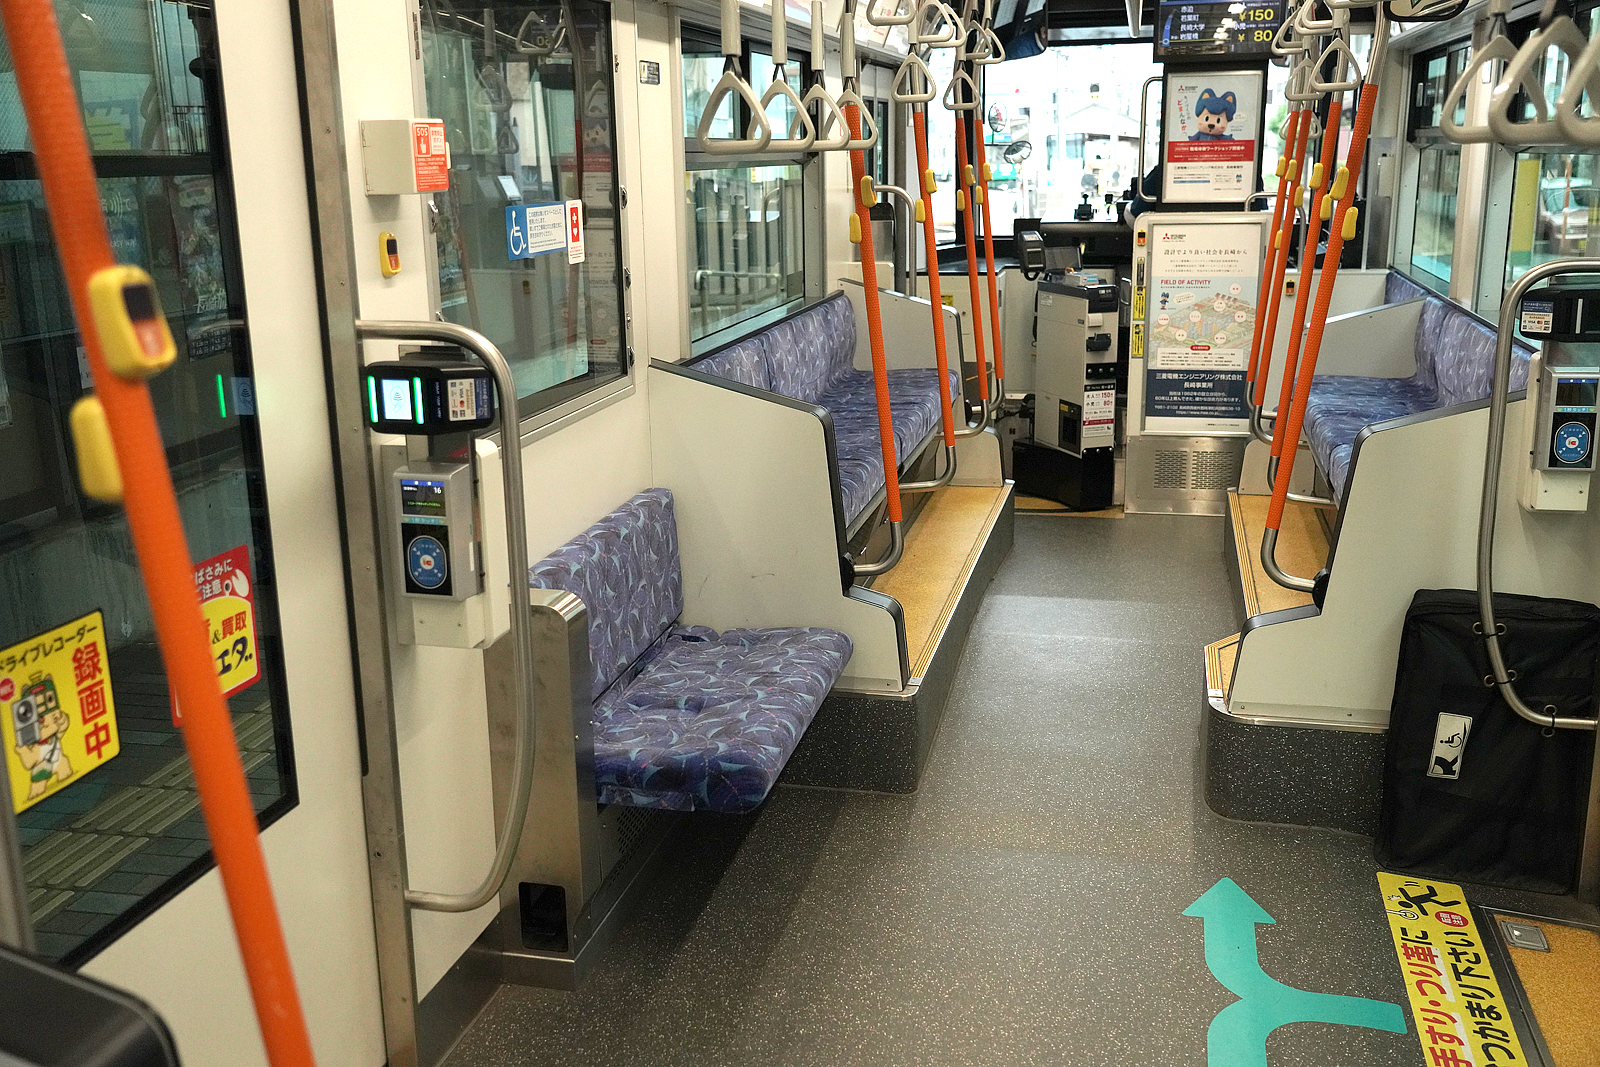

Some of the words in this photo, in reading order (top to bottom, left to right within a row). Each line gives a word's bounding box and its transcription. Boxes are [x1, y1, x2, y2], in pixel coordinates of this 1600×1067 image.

[1180, 23, 1205, 31] 長崎大学
[1253, 29, 1273, 42] 80
[416, 127, 429, 137] SOS
[1156, 372, 1243, 381] 三菱電機エンジニアリング株式会社
[1184, 381, 1214, 389] 長崎事業所
[433, 486, 442, 494] 16
[72, 641, 112, 760] 録画中
[1400, 926, 1473, 1067] 手すり・つり革に
[1443, 931, 1517, 1067] つかまり下さい
